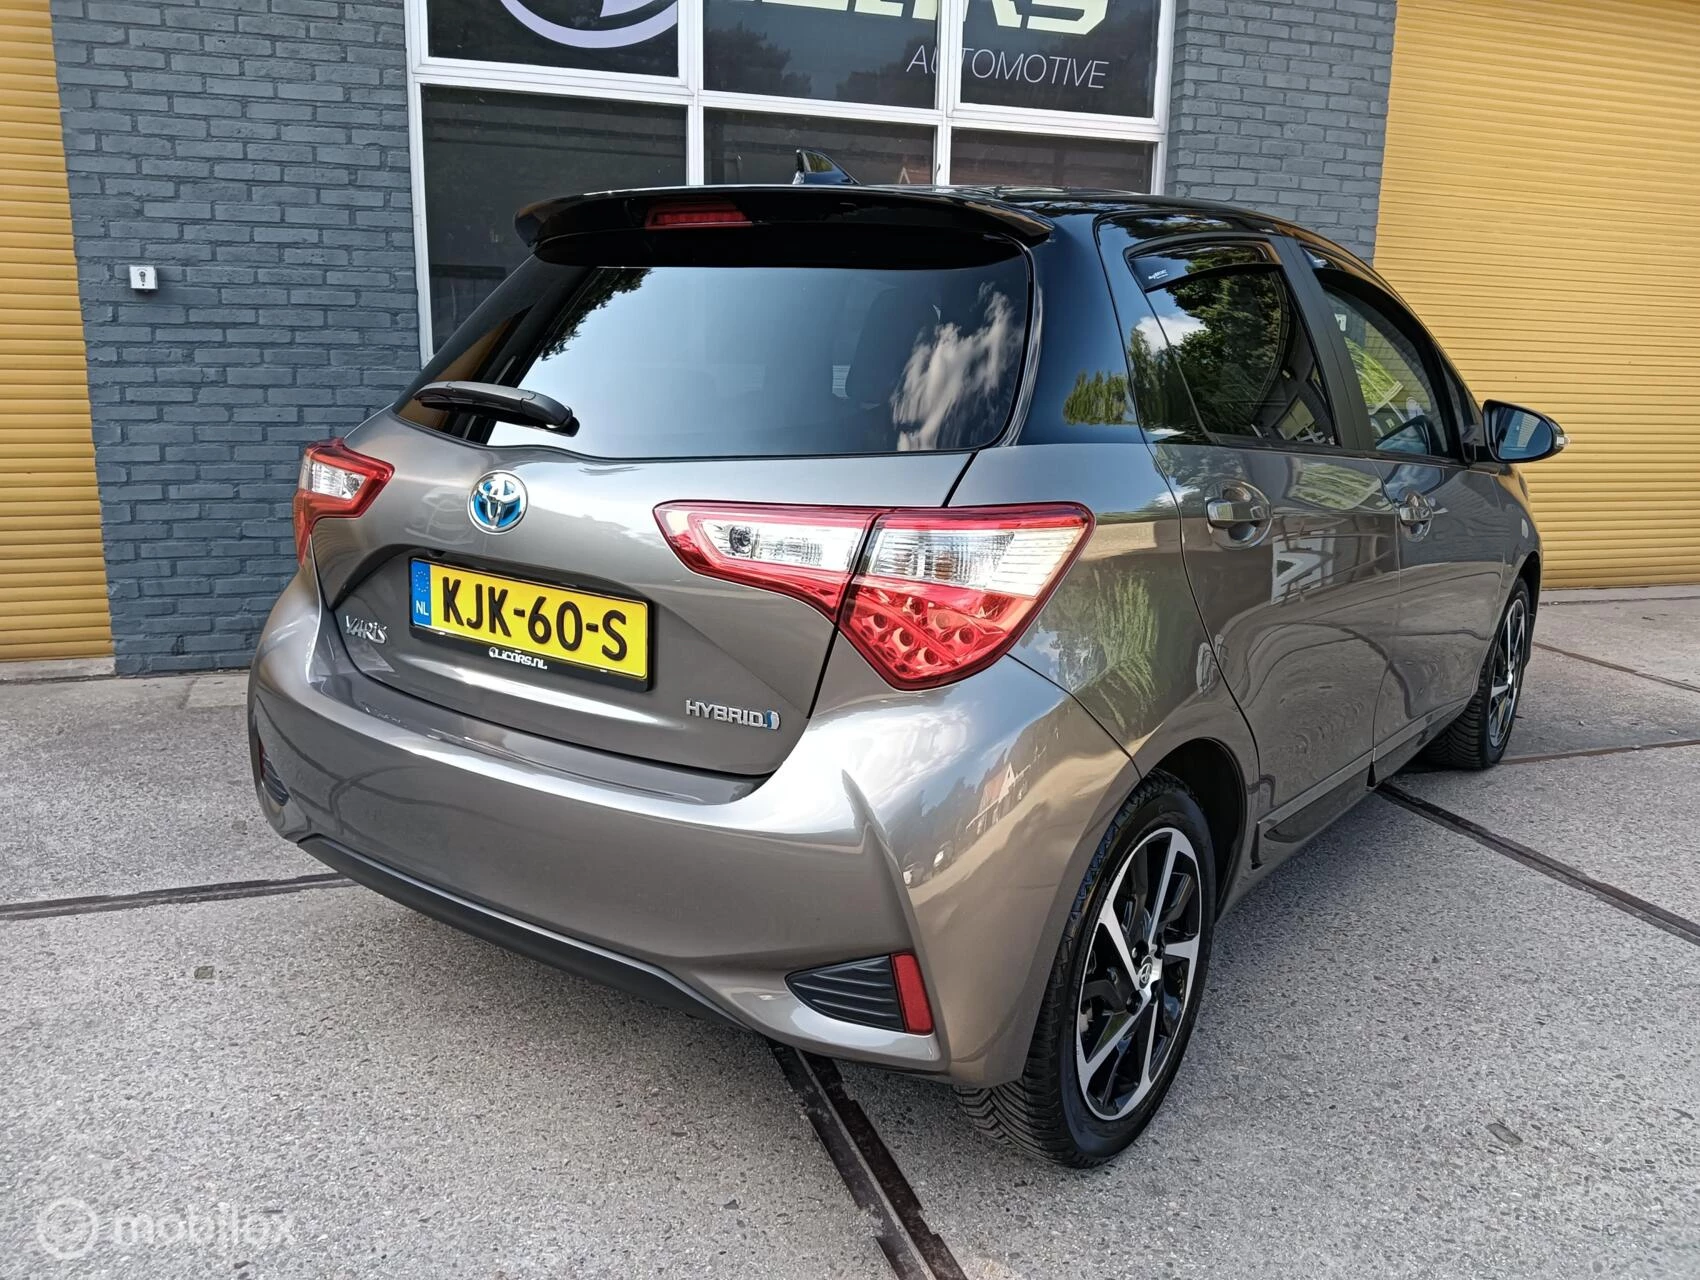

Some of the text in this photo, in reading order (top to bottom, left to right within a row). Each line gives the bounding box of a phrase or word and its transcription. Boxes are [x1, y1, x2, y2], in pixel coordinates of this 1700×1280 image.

[415, 601, 429, 617] NL
[442, 576, 628, 662] KJK-60-S
[685, 699, 764, 728] HYBRID
